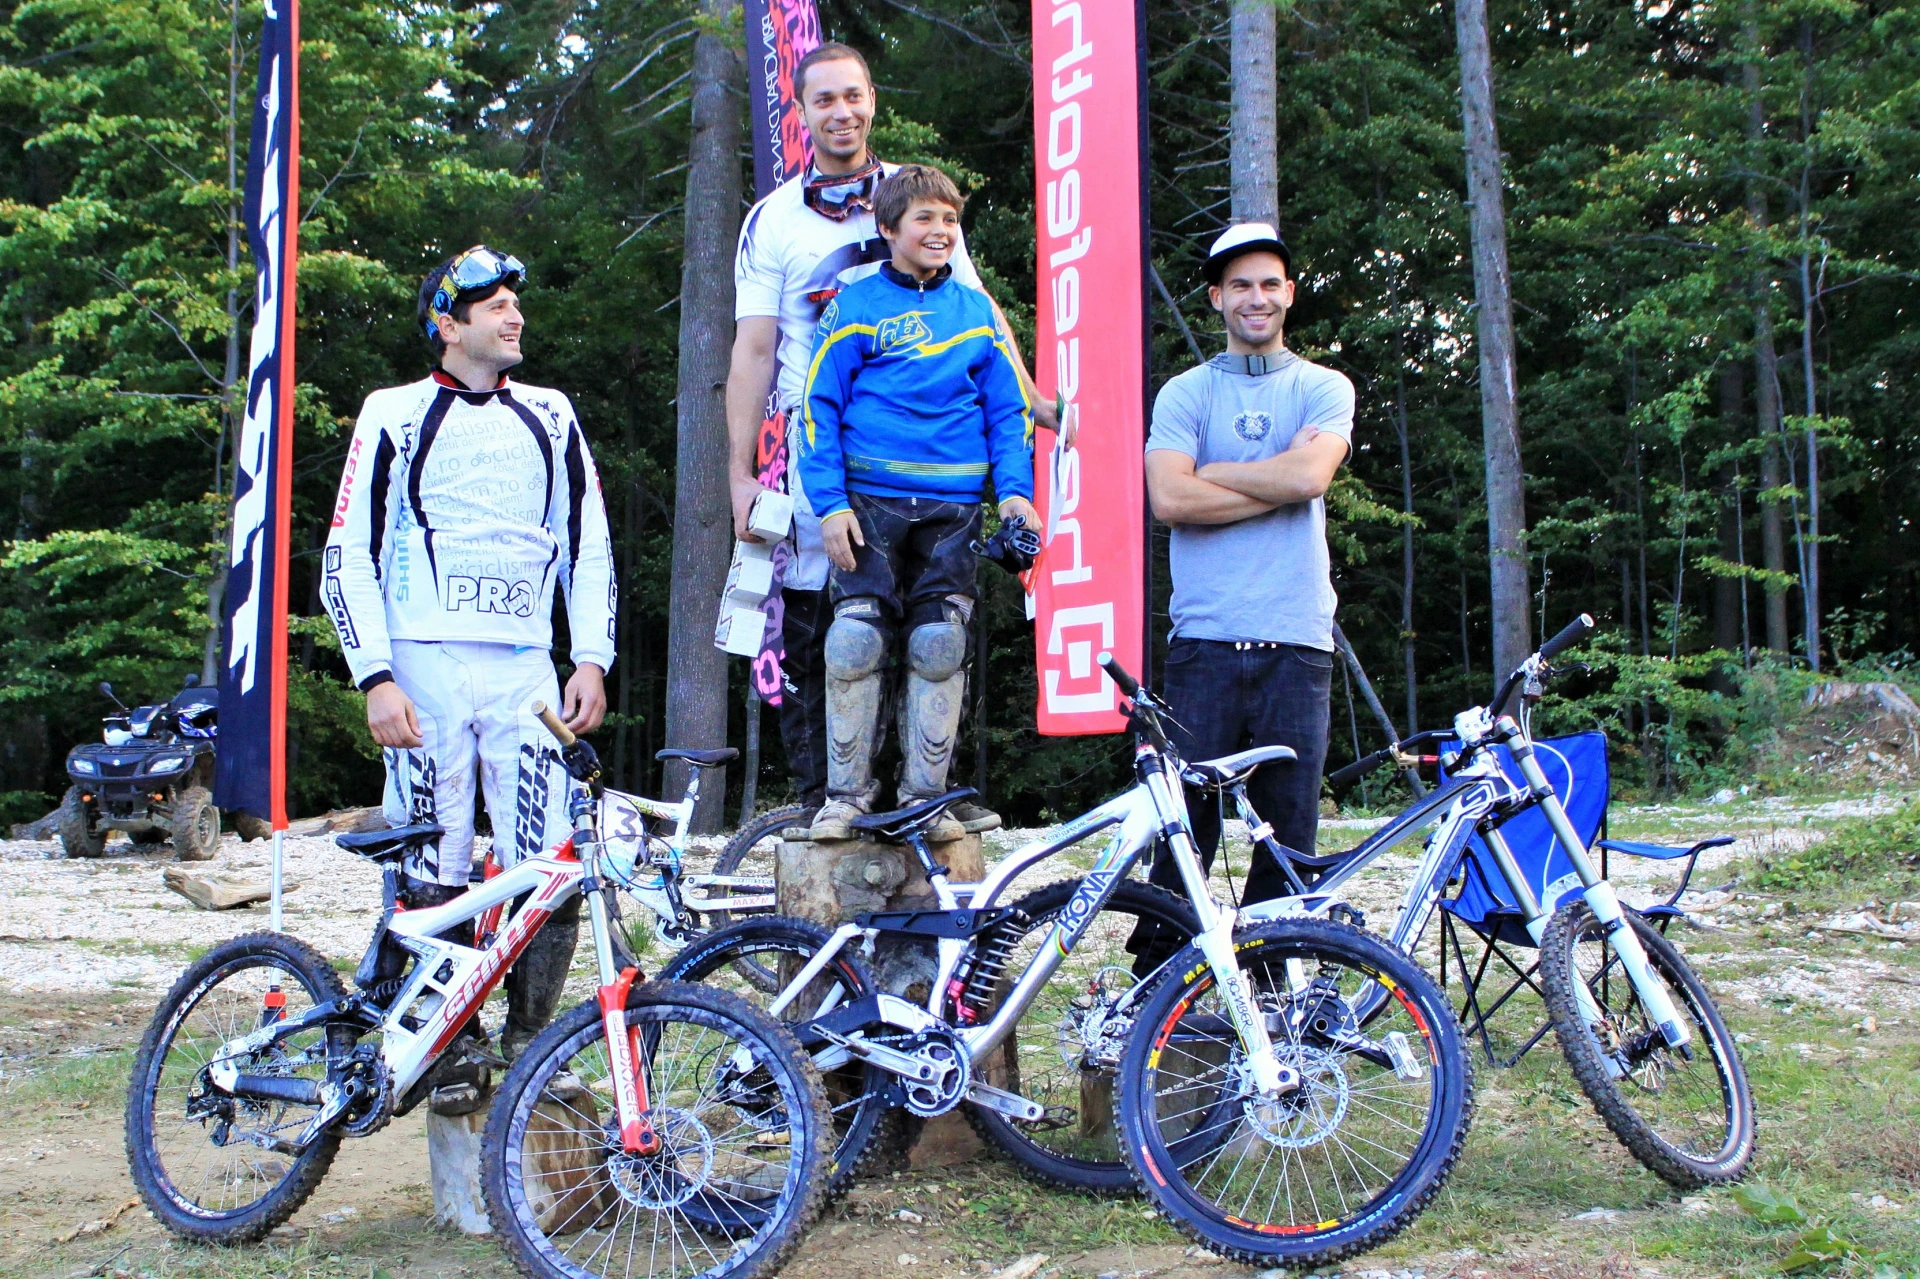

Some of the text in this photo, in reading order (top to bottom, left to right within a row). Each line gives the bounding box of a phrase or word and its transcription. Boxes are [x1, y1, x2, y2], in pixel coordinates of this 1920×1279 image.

[462, 434, 496, 449] despre
[331, 437, 363, 528] KENDA
[326, 576, 360, 650] SCOTT
[447, 575, 535, 618] PRO
[1057, 869, 1116, 935] KONA
[1399, 882, 1441, 955] REK
[1225, 975, 1255, 1035] BOMBER
